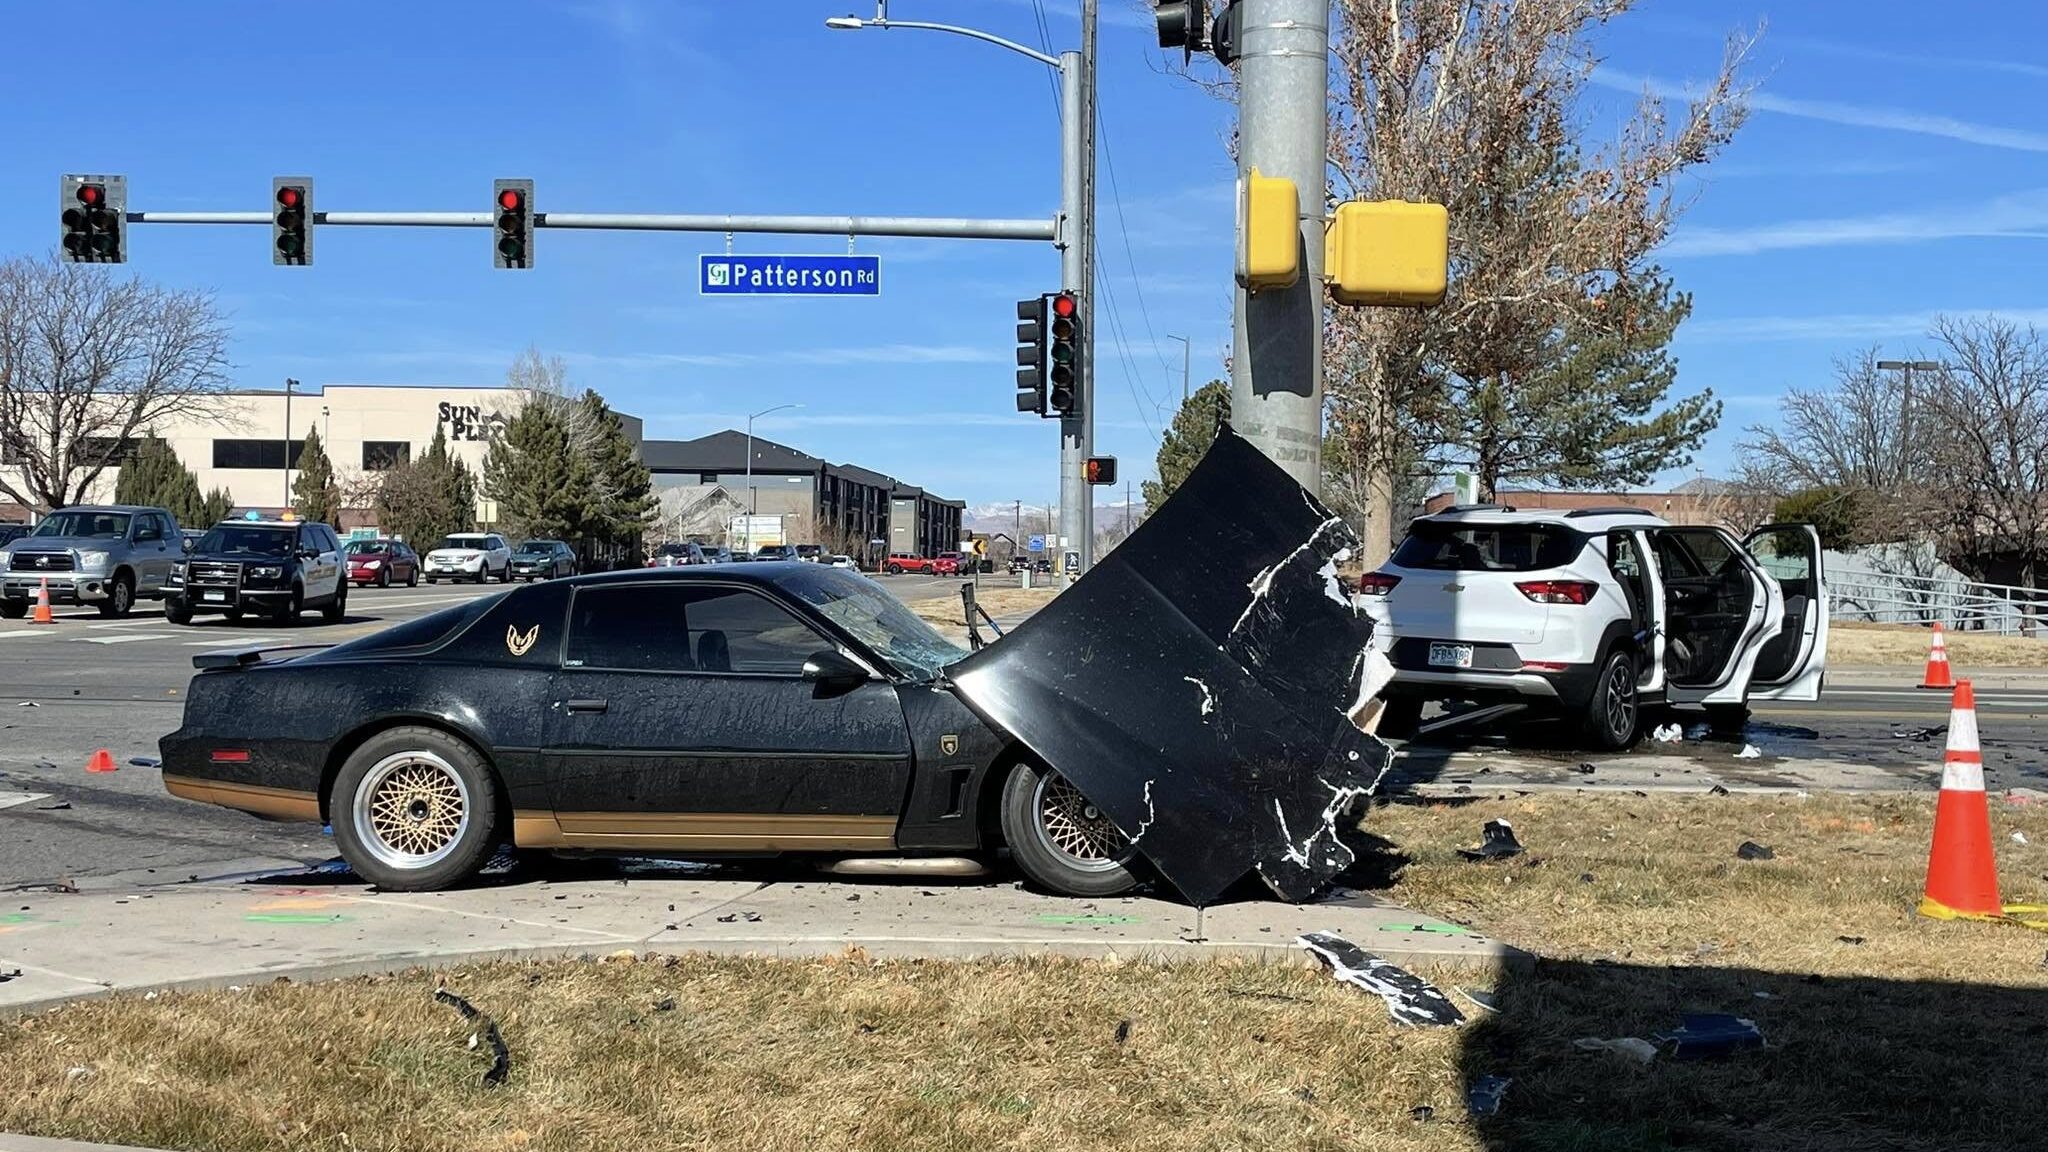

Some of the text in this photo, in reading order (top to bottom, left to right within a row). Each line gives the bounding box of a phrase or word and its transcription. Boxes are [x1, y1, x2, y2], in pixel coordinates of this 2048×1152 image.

[734, 263, 852, 286] Patterson
[857, 269, 874, 283] Rd
[439, 401, 480, 422] SUN
